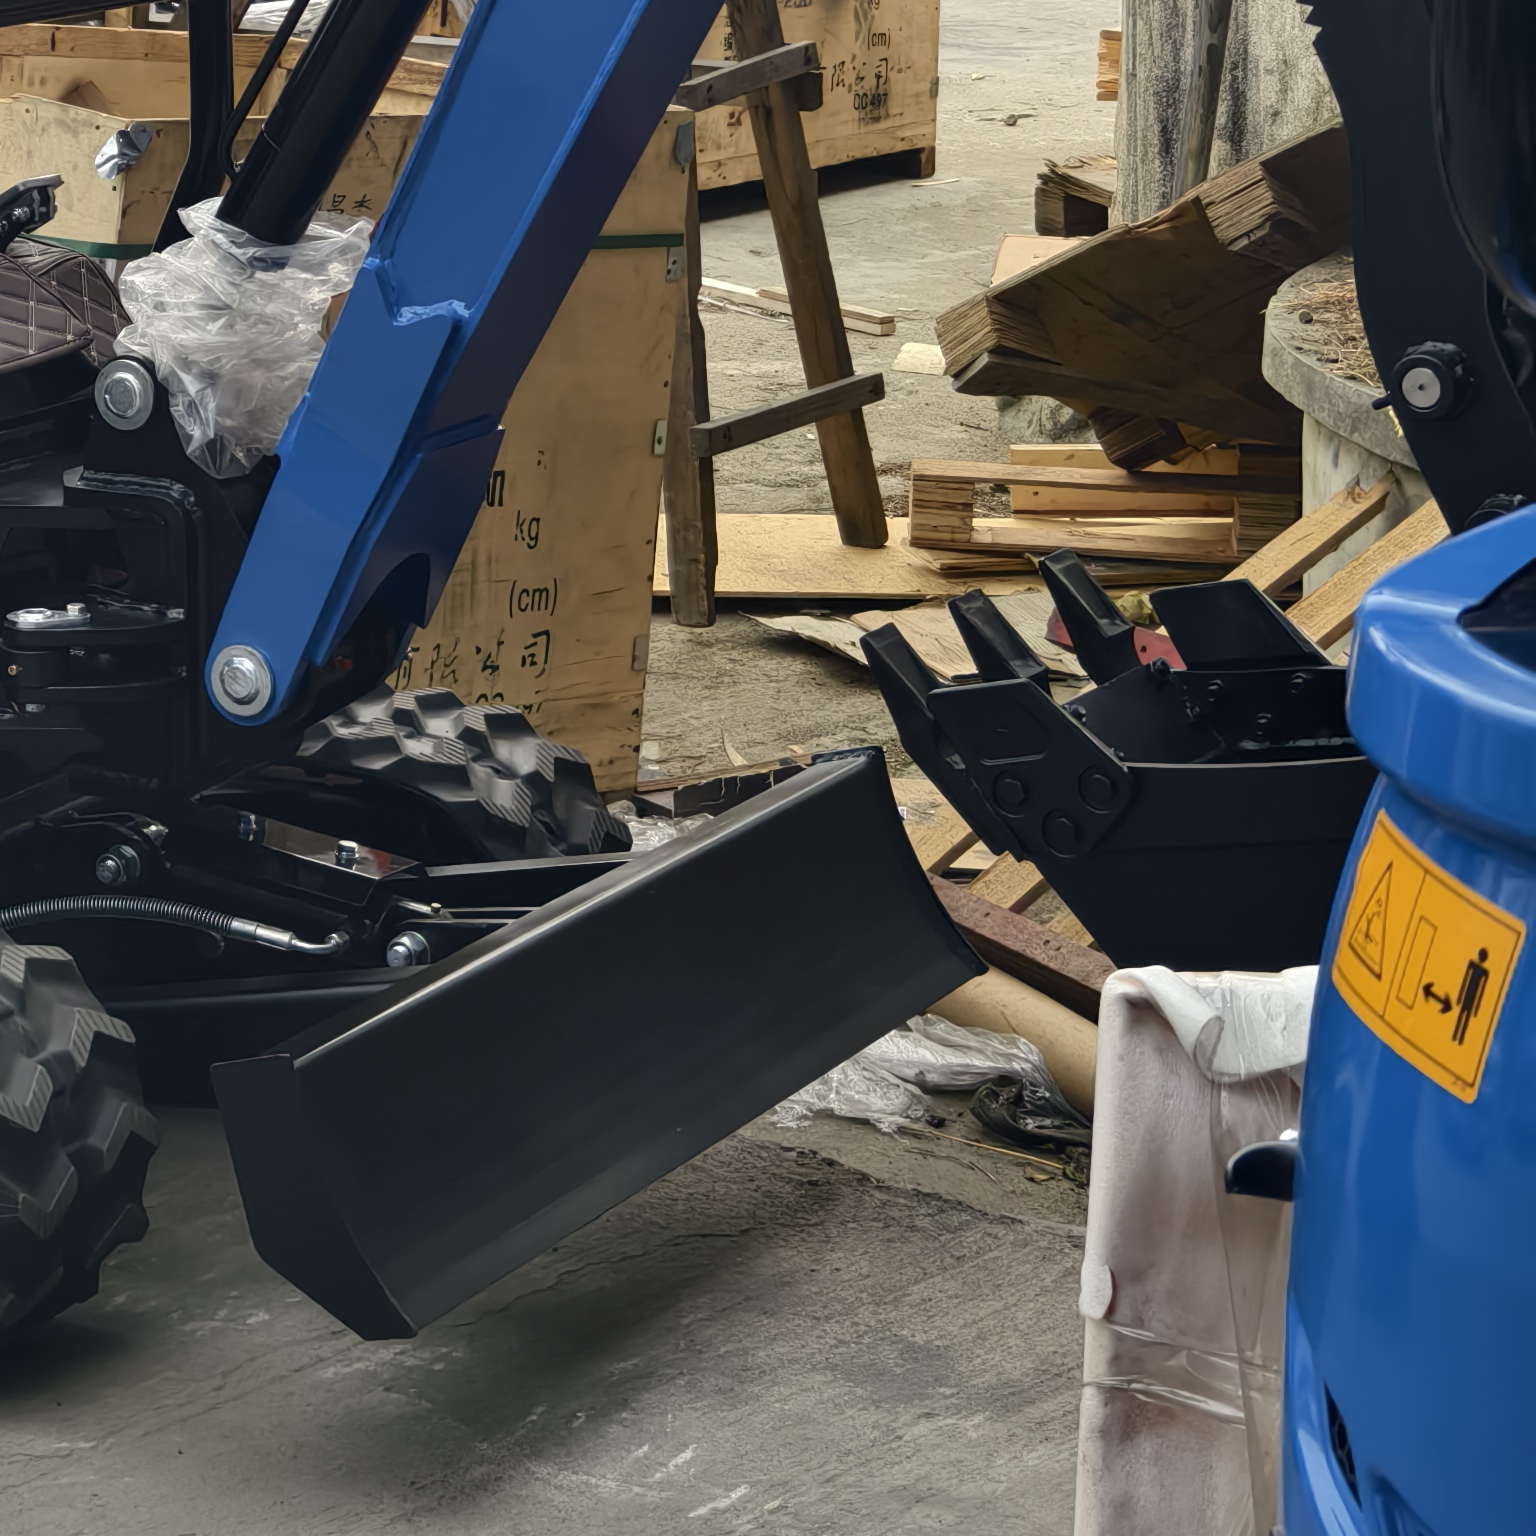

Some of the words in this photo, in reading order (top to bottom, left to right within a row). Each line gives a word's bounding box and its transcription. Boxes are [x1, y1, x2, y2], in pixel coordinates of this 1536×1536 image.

[867, 27, 891, 51] (cm)
[514, 509, 541, 550] kg
[509, 577, 558, 619] (cm)
